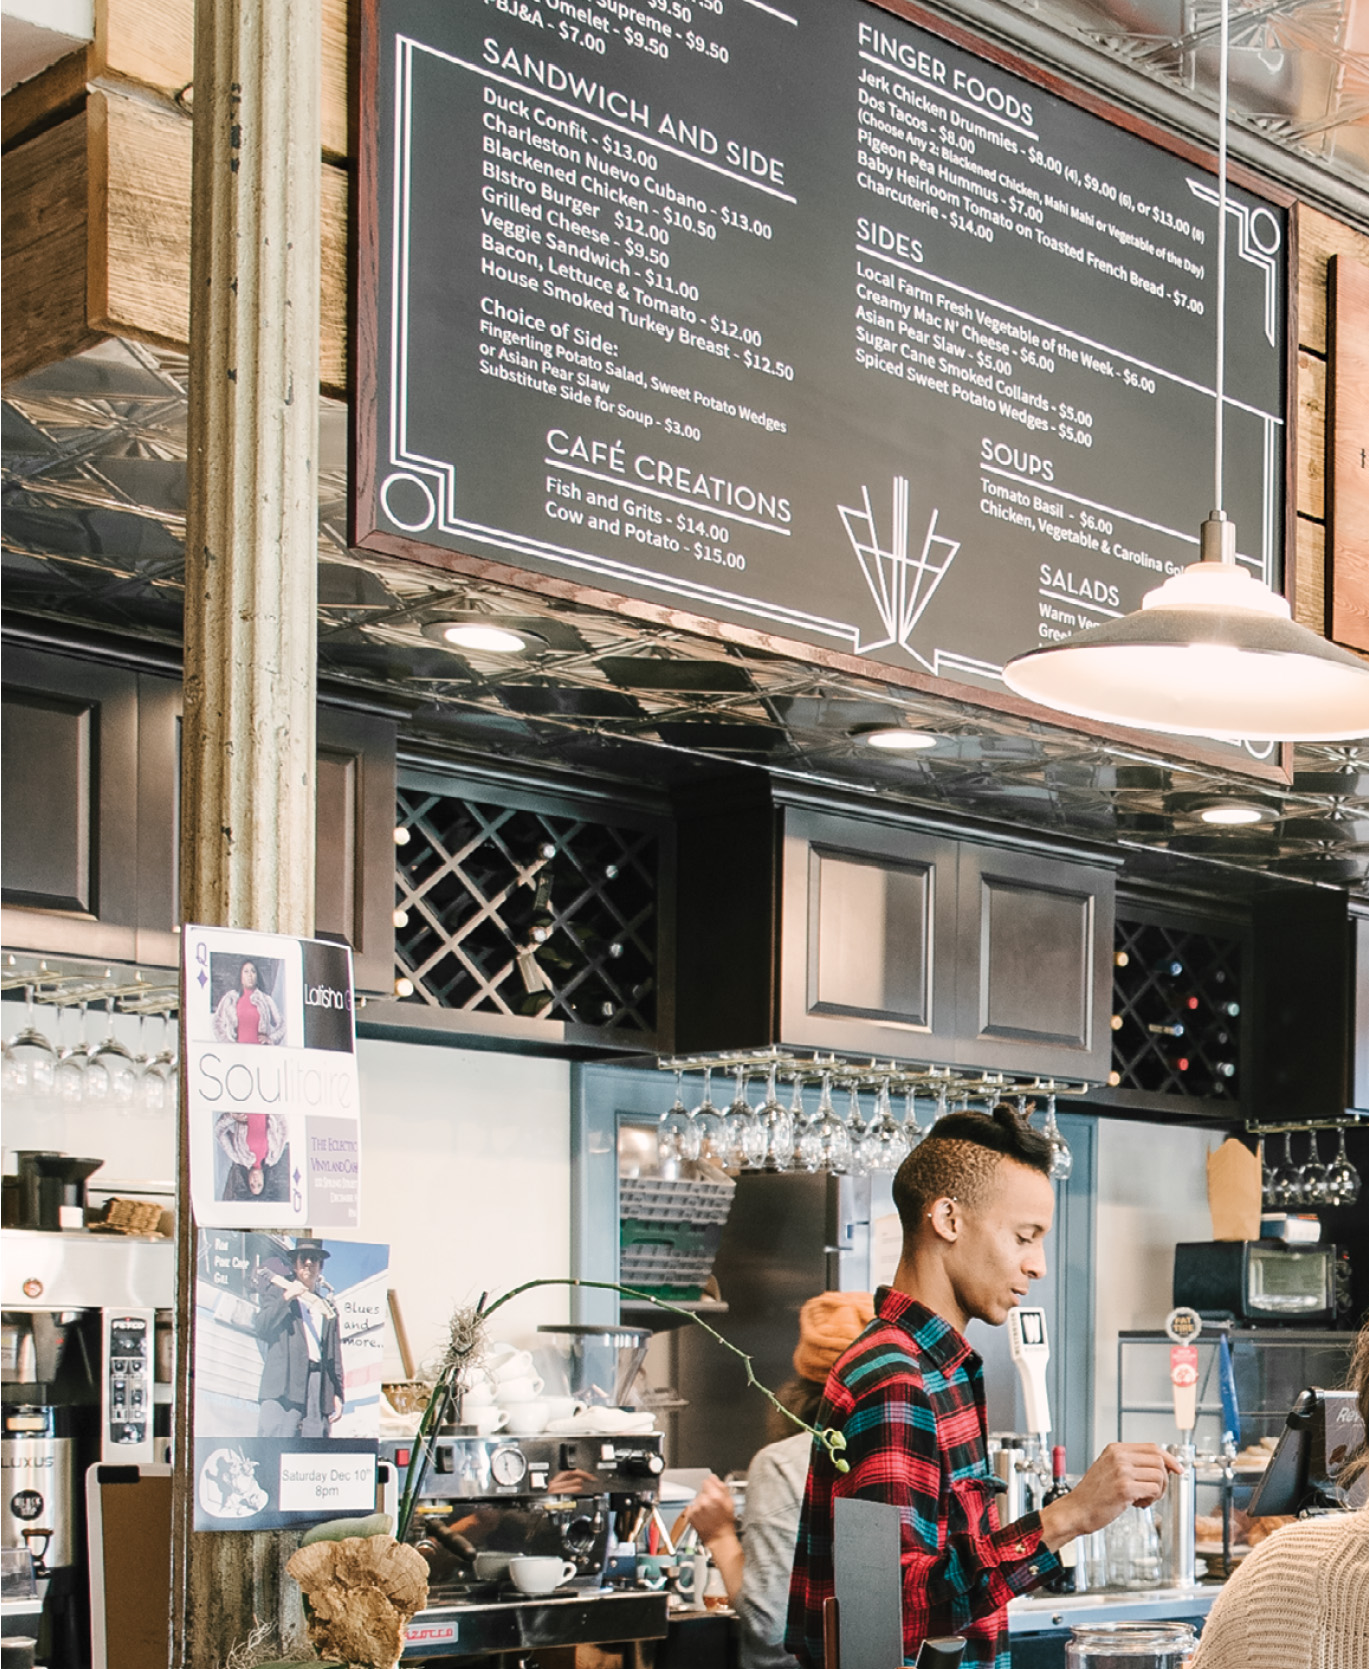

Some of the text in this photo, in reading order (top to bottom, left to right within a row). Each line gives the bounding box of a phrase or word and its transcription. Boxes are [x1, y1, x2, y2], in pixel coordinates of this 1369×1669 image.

[483, 38, 784, 185] SANDWICH AND SIDE
[859, 22, 1033, 126] FINGER FOODS
[484, 87, 657, 171] Duck Confit $13.00
[858, 88, 975, 154] Dos Tacos $8.00
[858, 68, 890, 94] Jerk
[892, 83, 947, 121] Chicken
[950, 110, 1018, 154] Drummies
[1028, 146, 1062, 175] $8.00
[1084, 173, 1117, 201] $9.00
[1137, 202, 1151, 216] or
[1152, 206, 1190, 235] $13.00
[483, 112, 772, 239] Charleston Nuevo Cubano $13.00
[483, 136, 716, 240] Blackened Chicken $10.50
[483, 160, 669, 245] Bistro Burger $12.00
[857, 172, 994, 242] Charcuterie $14.00
[858, 128, 1043, 223] Pigeon Pea Hummus $7.00
[481, 207, 698, 301] Veggie Sandwich $11.00
[482, 186, 669, 268] Grilled Cheese $9.50
[856, 217, 923, 263] SIDES
[858, 150, 1204, 315] Baby Heirloom Tomato on Toasted French Bread $7.00
[481, 257, 794, 381] House Smoked Turkey Breast $12.50
[481, 297, 618, 357] Choice of Side:
[482, 233, 762, 347] Bacon, Lettuce & Tomato $12.00
[856, 283, 911, 319] Creamy
[914, 305, 942, 329] Mac
[962, 325, 1009, 356] Cheese
[1020, 347, 1054, 373] $6.00
[857, 261, 1155, 394] Local Farm Fresh Vegetable of the Week $6.00
[480, 319, 787, 433] Fingerling Potato Salad, Sweet Potato Wedges
[856, 326, 1092, 427] Sugar Cane Smoked Collards $5.00
[547, 429, 791, 522] CAFÉ CREATIONS
[981, 438, 1054, 481] SOUPS
[545, 501, 745, 570] Cow and Potato $15.00
[546, 476, 729, 543] Fish and Grits $14.00
[980, 477, 1113, 535] Tomato Basil $6.00
[1040, 564, 1119, 606] SALADS
[344, 1319, 369, 1330] and
[345, 1302, 380, 1315] Blues
[1, 1456, 54, 1468] LUXUS
[282, 1468, 327, 1483] Saturday
[330, 1469, 351, 1482] Dec
[315, 1485, 340, 1499] 8pm
